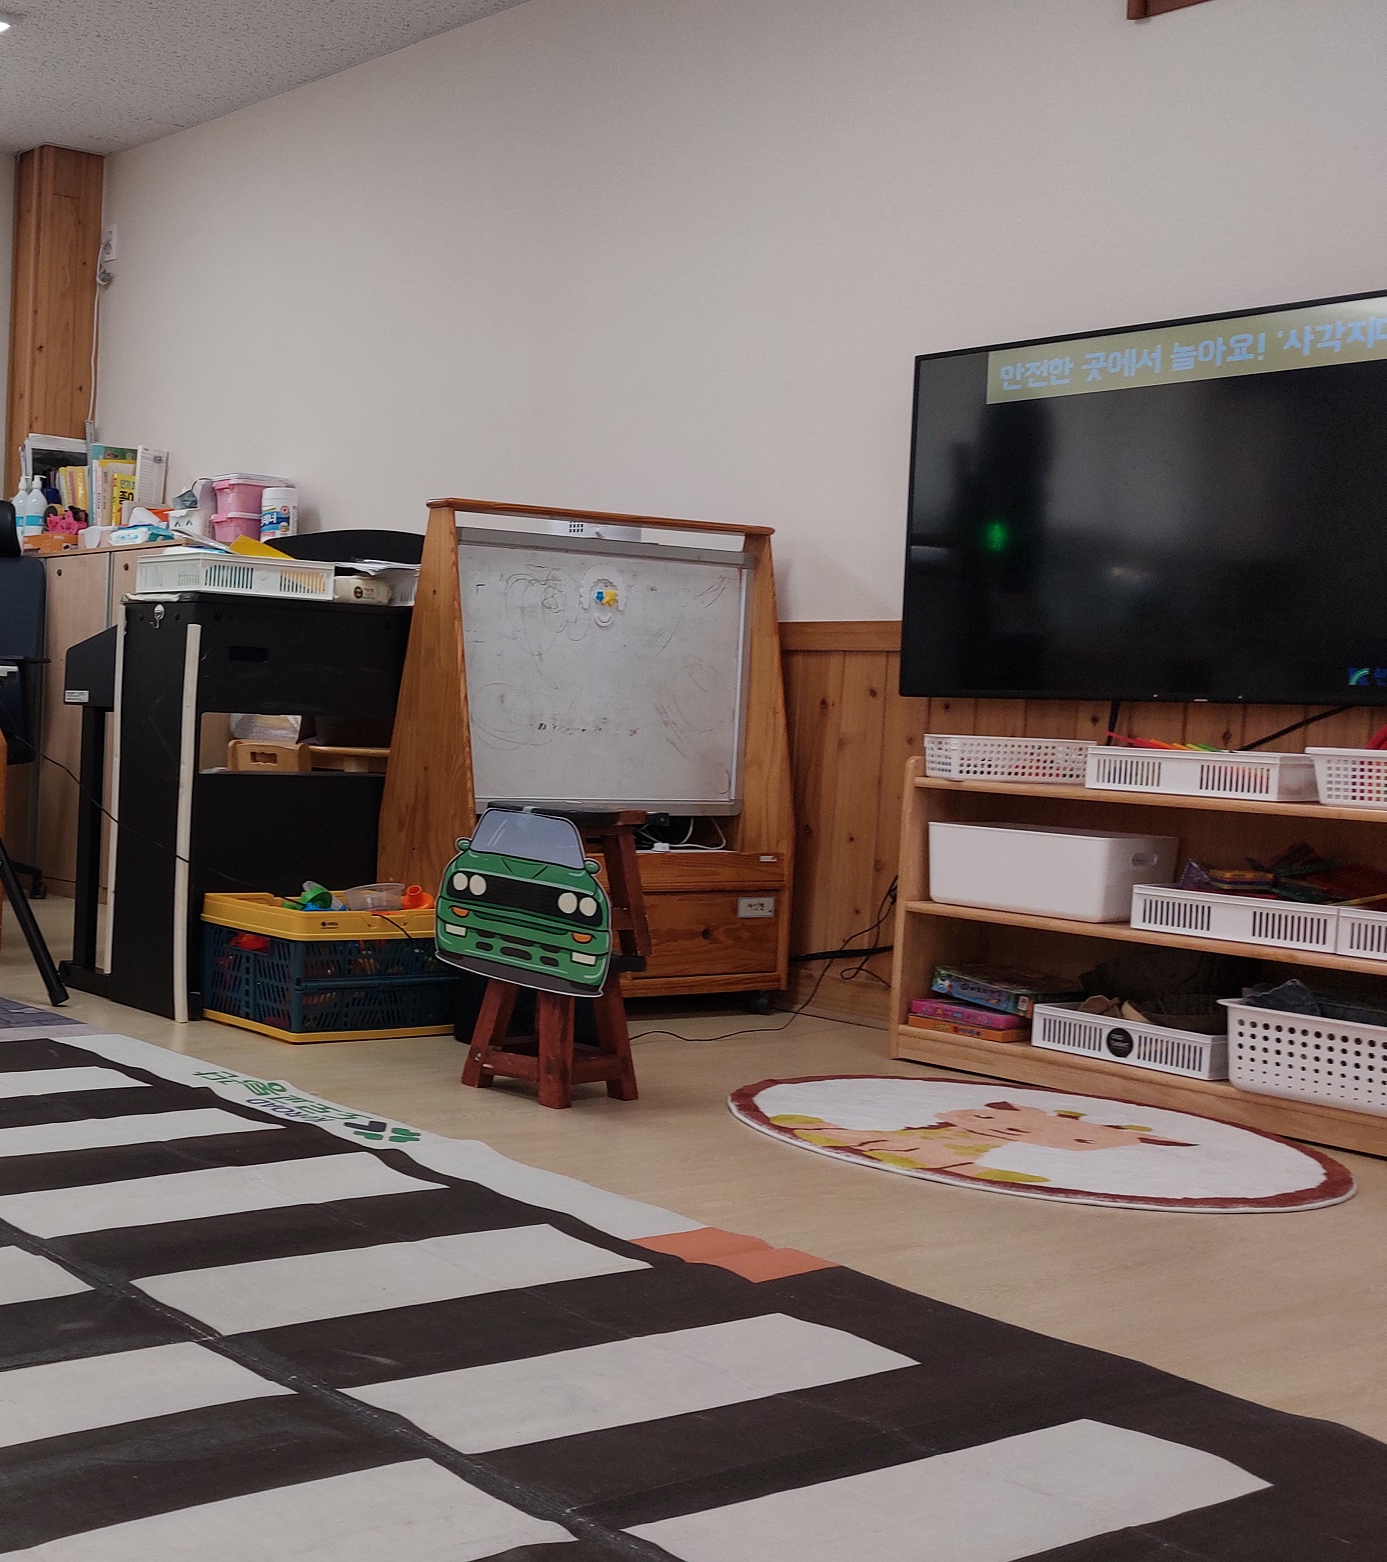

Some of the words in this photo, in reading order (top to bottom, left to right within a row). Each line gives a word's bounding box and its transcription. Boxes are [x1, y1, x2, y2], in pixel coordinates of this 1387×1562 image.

[1000, 356, 1073, 391] 안전한
[1081, 344, 1162, 383] 곳에서
[1170, 333, 1266, 373] 놀아요!
